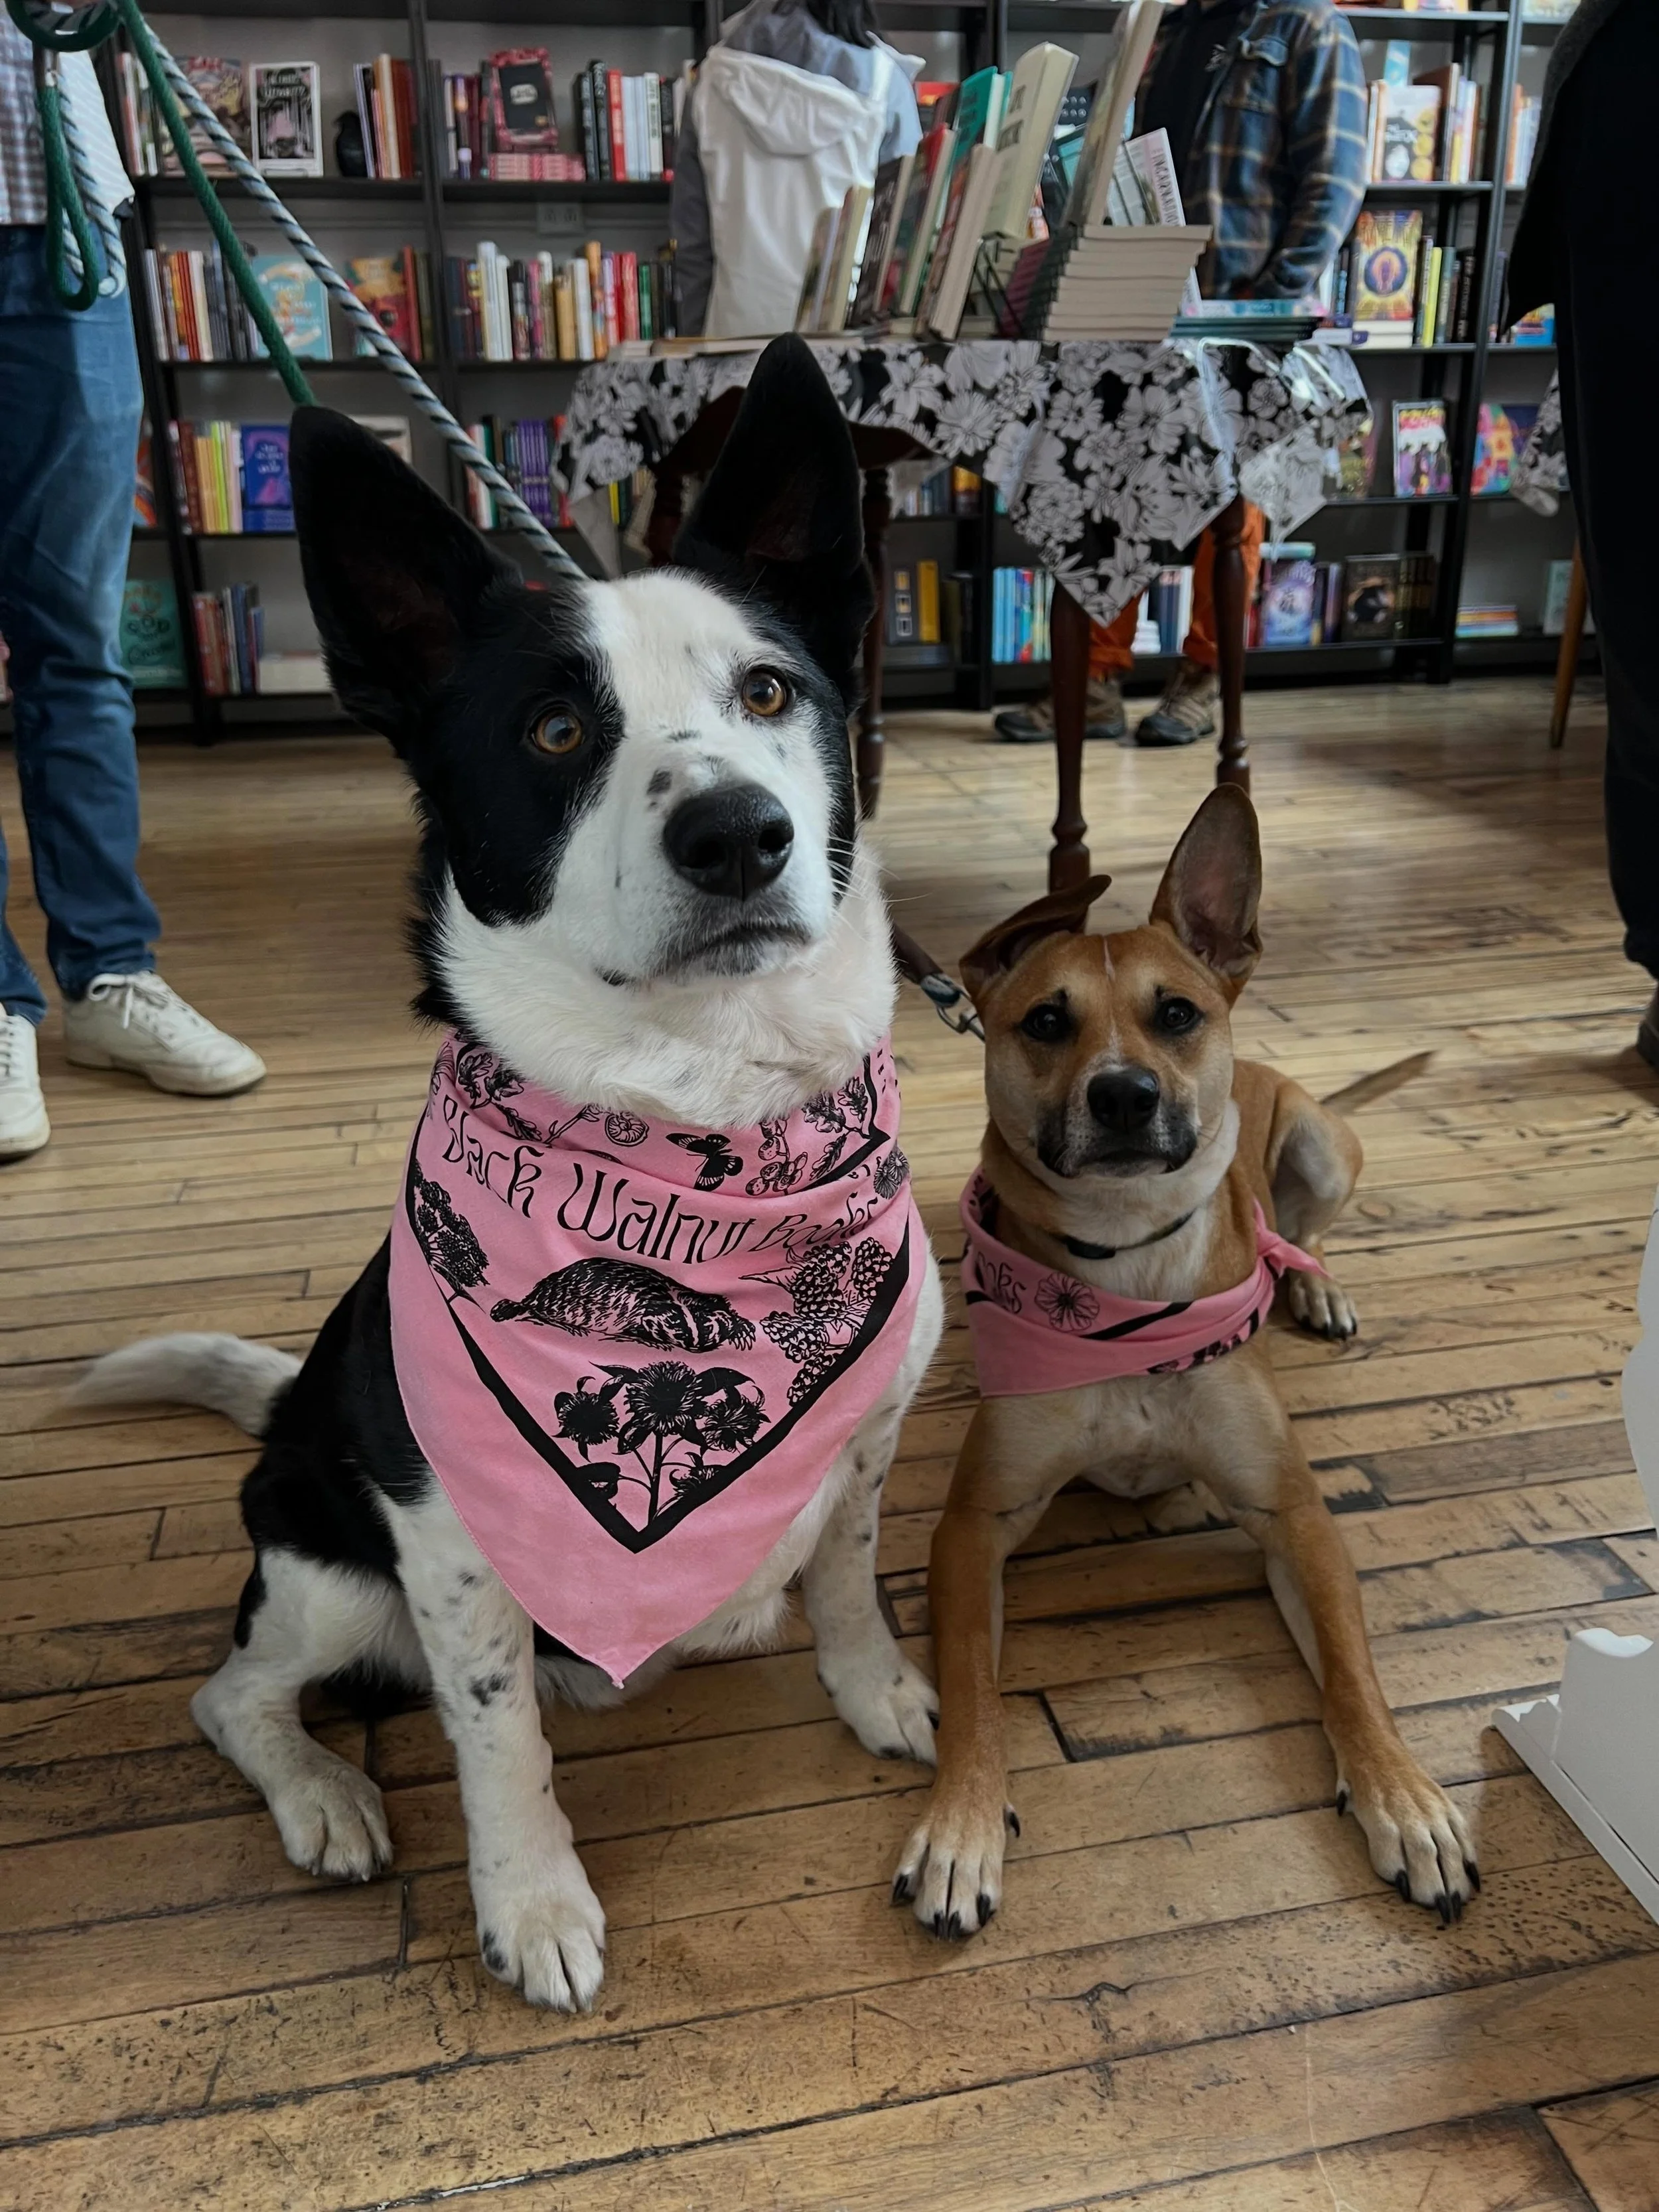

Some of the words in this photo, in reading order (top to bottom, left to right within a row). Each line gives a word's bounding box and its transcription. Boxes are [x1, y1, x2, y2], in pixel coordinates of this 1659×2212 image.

[442, 1094, 545, 1218] Black
[557, 1162, 757, 1264] Walnut
[747, 1191, 879, 1252] Books
